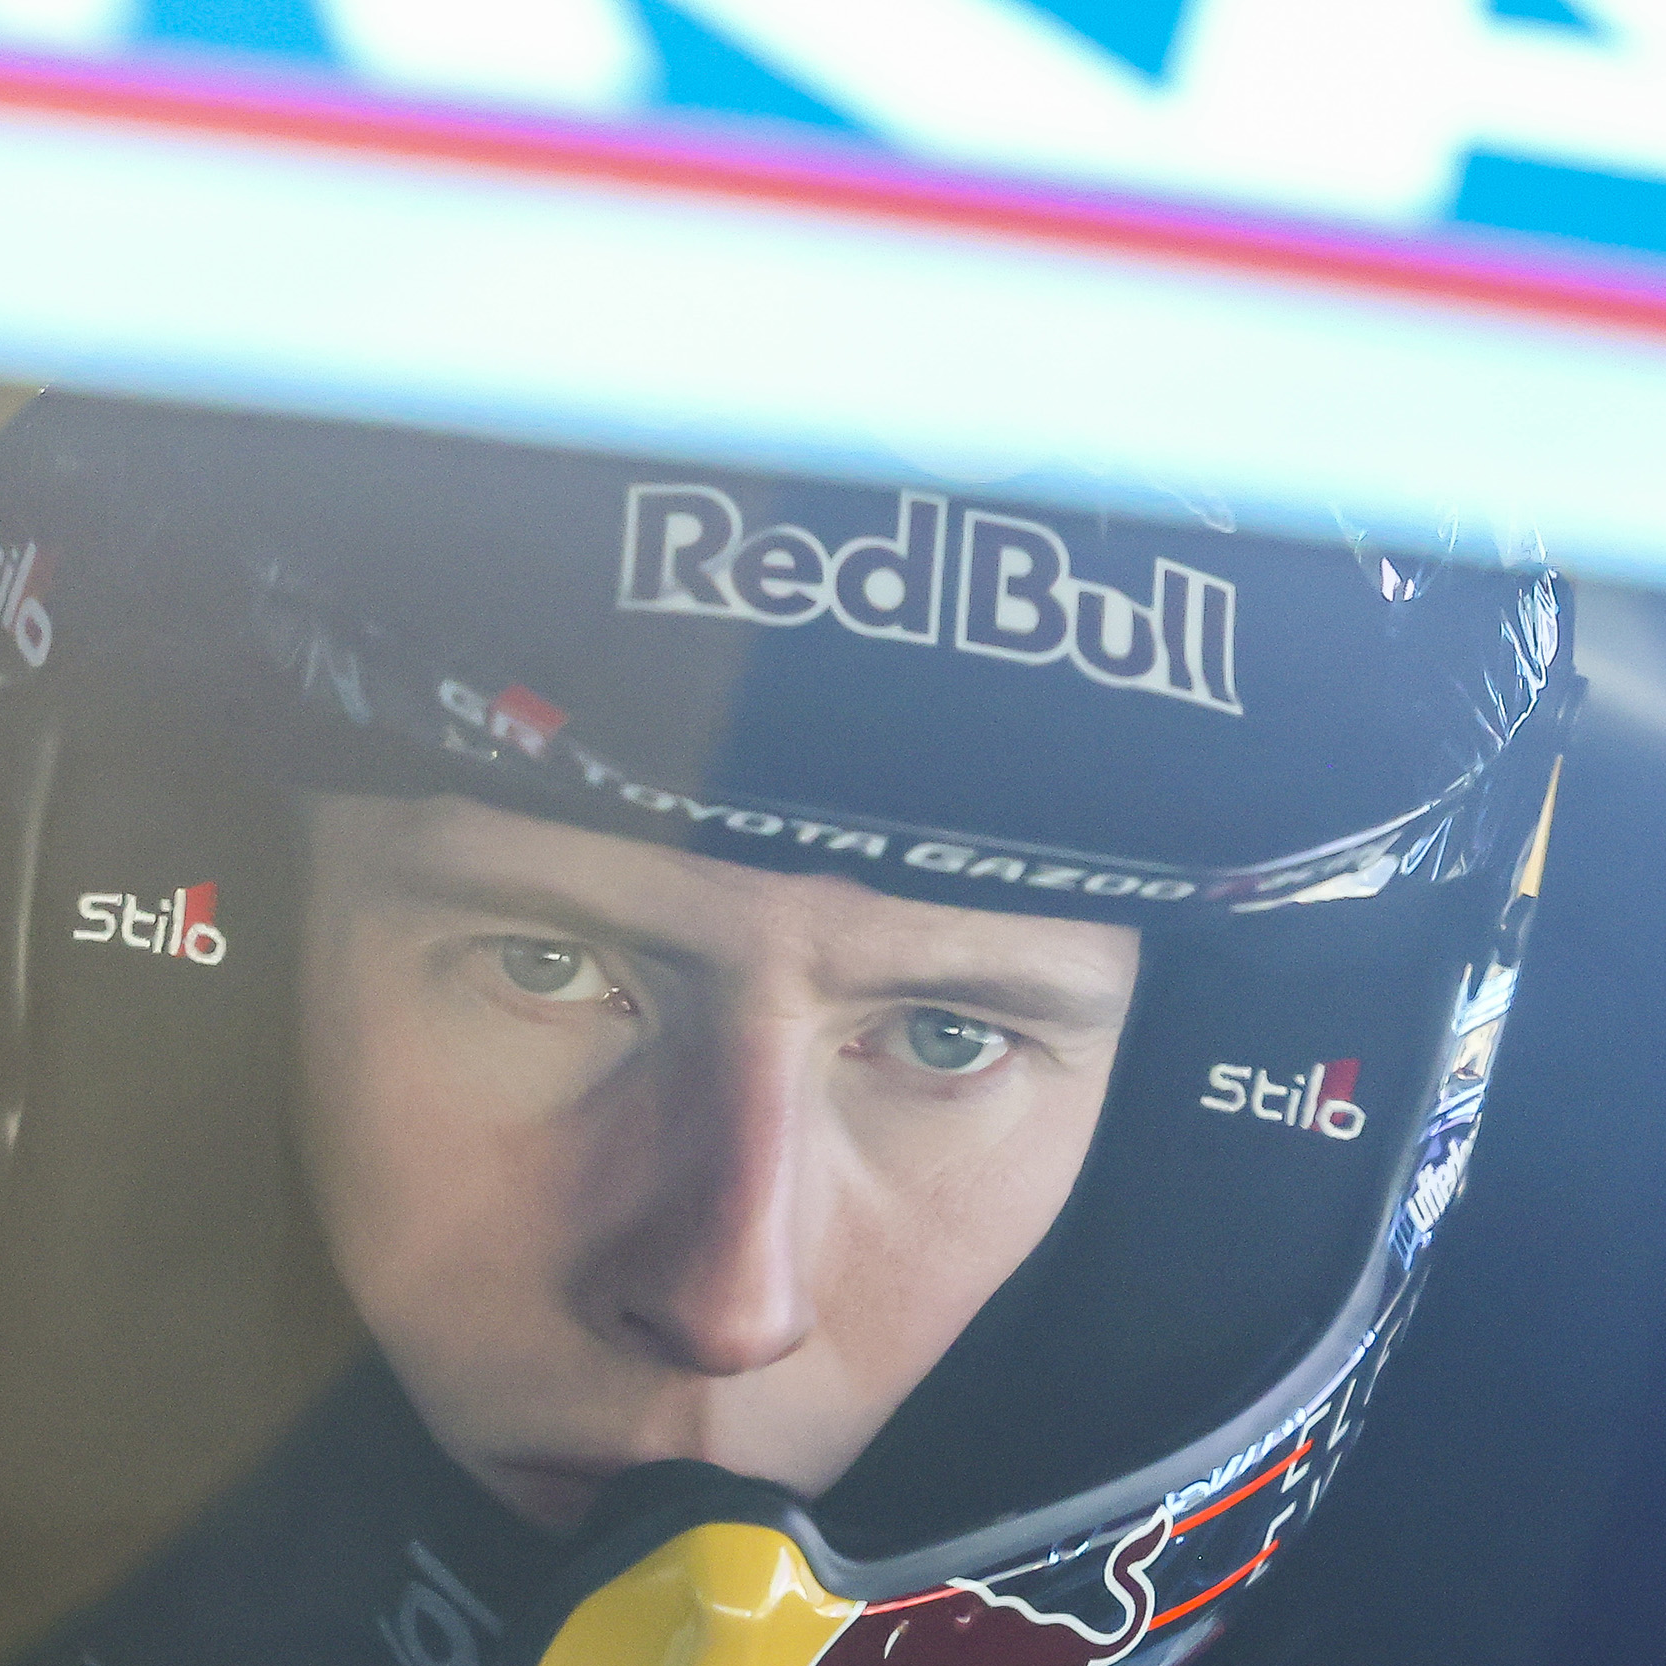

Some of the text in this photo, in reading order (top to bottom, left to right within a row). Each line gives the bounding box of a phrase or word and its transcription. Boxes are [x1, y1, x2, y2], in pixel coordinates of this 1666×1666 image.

[617, 483, 1244, 716] Red Bull
[573, 745, 889, 861] TOYOTA
[903, 842, 1199, 903] GAZOO
[72, 886, 228, 966] Stilo
[1199, 1061, 1366, 1141] Stilo
